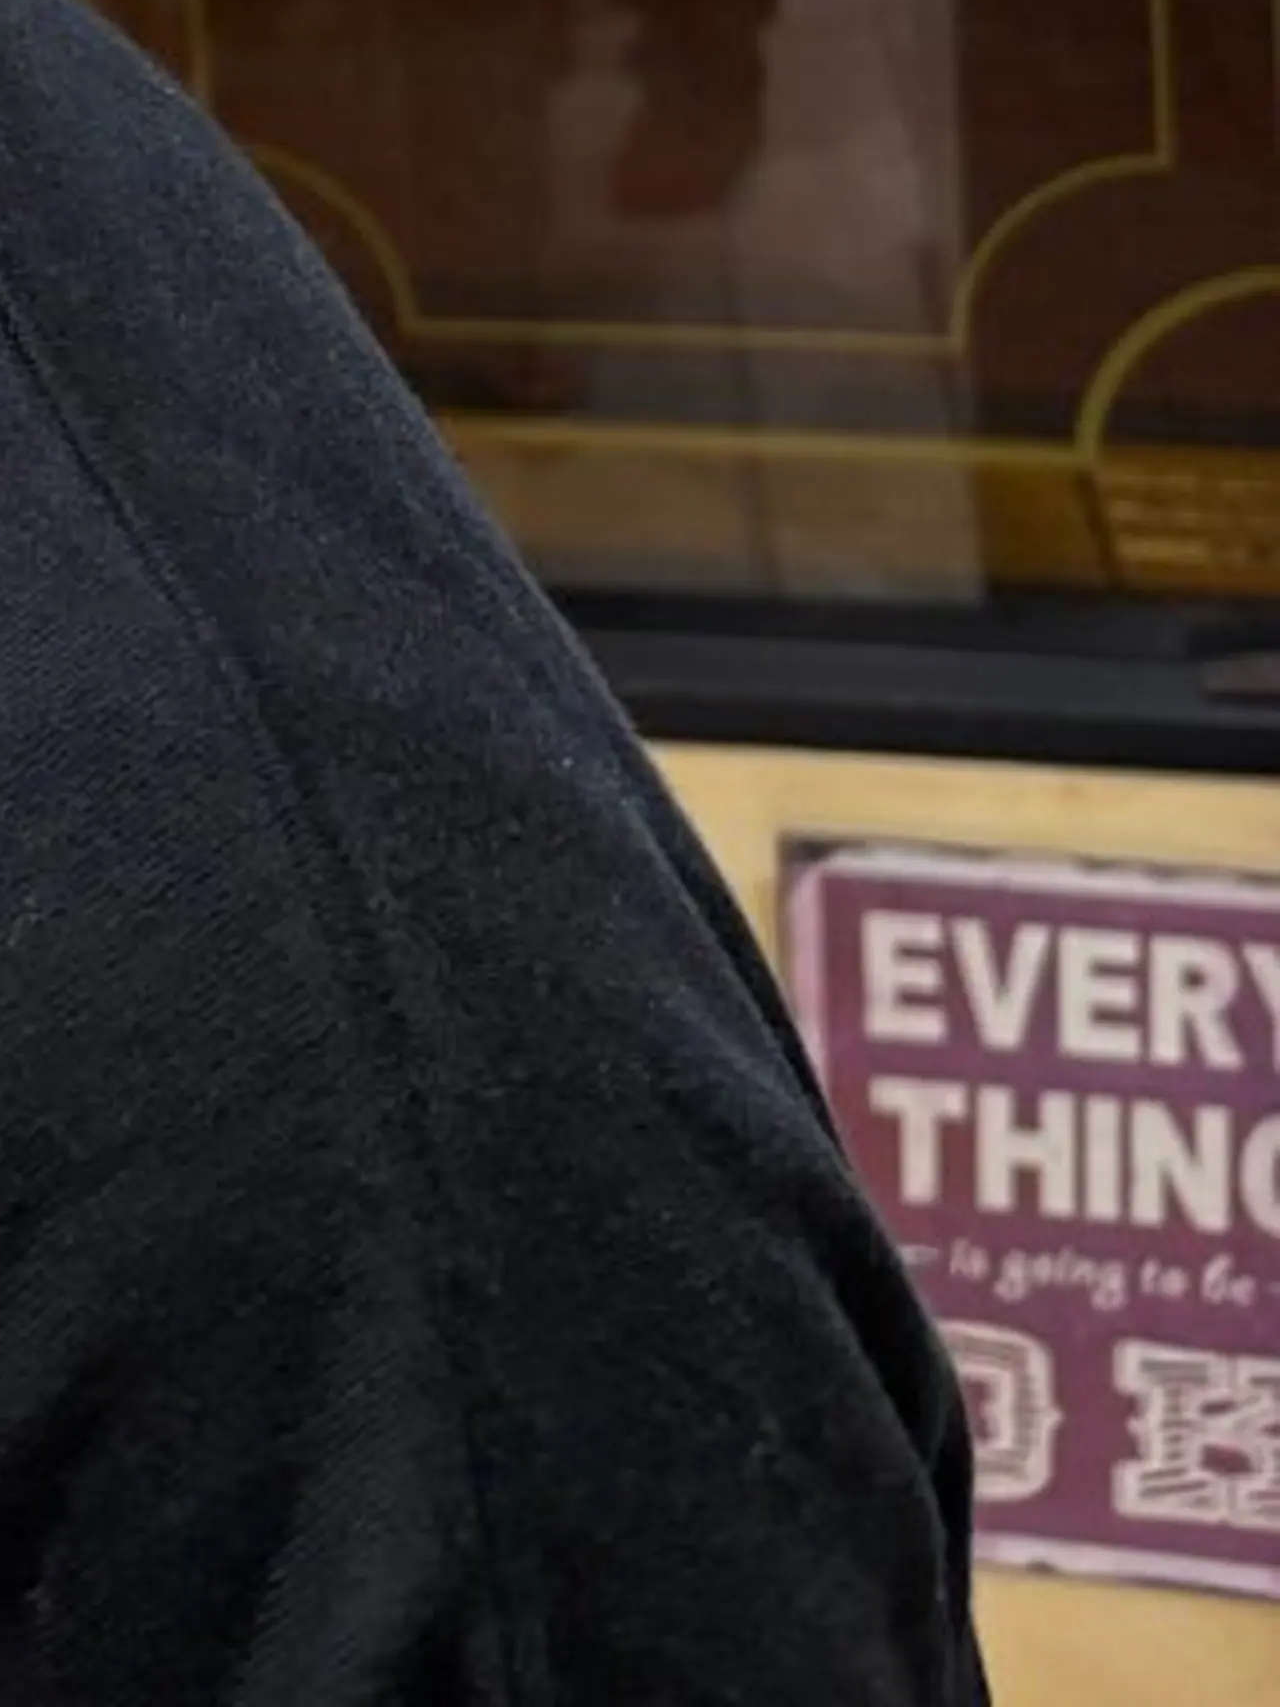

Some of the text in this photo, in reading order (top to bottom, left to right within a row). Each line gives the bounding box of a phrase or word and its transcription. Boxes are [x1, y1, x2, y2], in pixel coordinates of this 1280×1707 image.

[994, 1245, 1128, 1311] going
[1140, 1255, 1190, 1299] to
[1199, 1252, 1258, 1308] be
